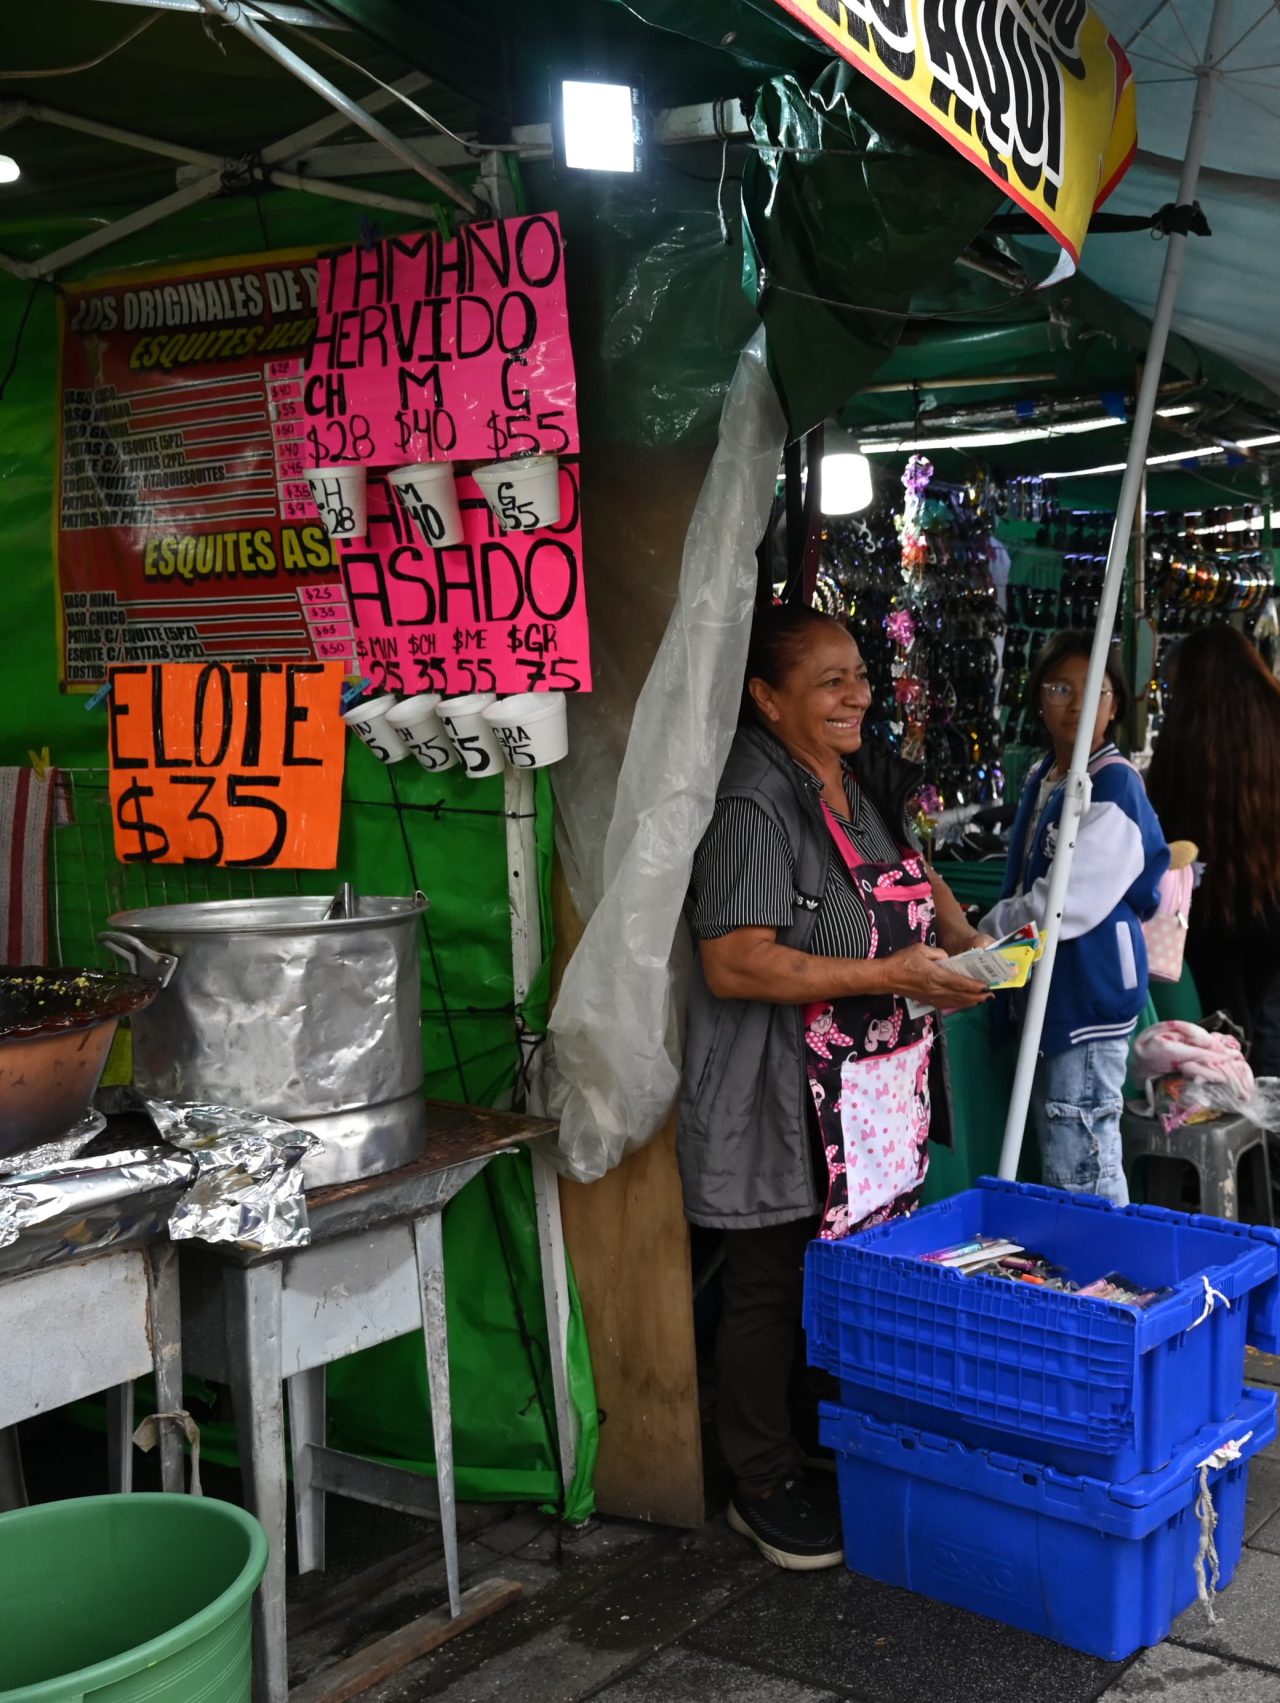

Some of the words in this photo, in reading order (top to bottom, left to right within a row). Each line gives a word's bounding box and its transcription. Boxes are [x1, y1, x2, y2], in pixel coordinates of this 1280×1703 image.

[317, 216, 561, 314] TAMAÑO
[123, 273, 264, 332] ORIGINALES
[266, 269, 304, 313] DE
[129, 325, 264, 369] ESQUITES
[304, 291, 537, 371] HERVIDO
[304, 373, 346, 418] CH
[398, 364, 443, 410] M
[501, 355, 531, 415] G
[306, 413, 376, 468] $28
[394, 408, 457, 459] $40
[486, 410, 570, 463] $55
[498, 482, 517, 512] G
[144, 531, 277, 579] ESQUITES
[282, 525, 339, 570] AS
[341, 537, 578, 628] ASADO
[88, 609, 126, 625] CHICO
[507, 623, 559, 660] $GR
[369, 660, 405, 695] 25
[413, 657, 447, 695] 35
[457, 658, 497, 695] 55
[515, 658, 581, 693] 75
[108, 660, 325, 769] ELOTE
[365, 738, 391, 762] 5
[408, 736, 450, 770] 35
[117, 774, 287, 867] $35
